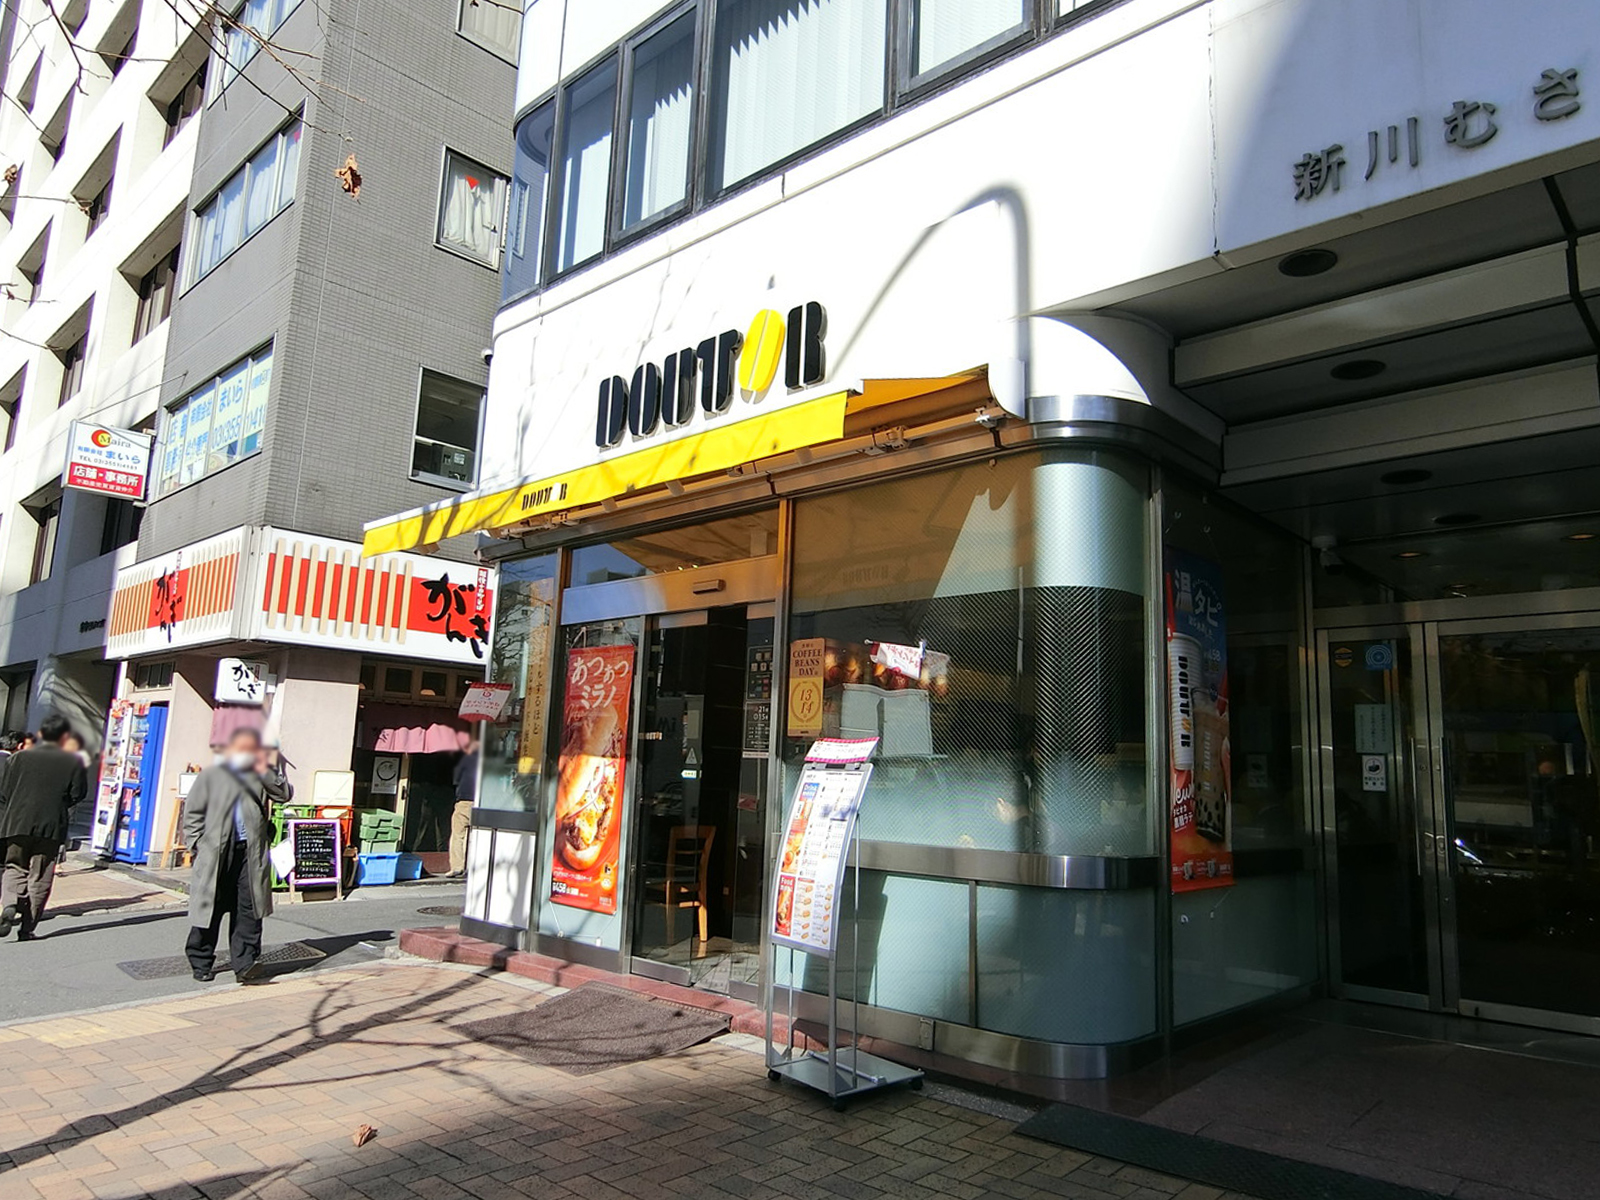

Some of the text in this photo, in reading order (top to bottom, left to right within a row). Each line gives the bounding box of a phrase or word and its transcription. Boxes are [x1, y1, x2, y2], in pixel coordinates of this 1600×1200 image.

[1293, 68, 1581, 200] 新川むさ
[596, 301, 828, 448] DOUTOR
[100, 434, 131, 448] Maira
[80, 455, 92, 463] TEL
[105, 450, 141, 464] まいら
[73, 465, 139, 487] 店舗・事務所
[521, 482, 567, 511] DOUTOR
[420, 572, 492, 658] がんぎ
[793, 648, 822, 658] COFFEE
[794, 659, 820, 667] BEANS
[231, 664, 261, 699] がんぎ
[571, 657, 629, 685] あつあつ
[799, 667, 815, 676] DAY
[581, 684, 616, 709] ミラノ
[800, 689, 813, 701] 13
[1178, 655, 1192, 748] DOUTOR
[800, 701, 814, 714] 14
